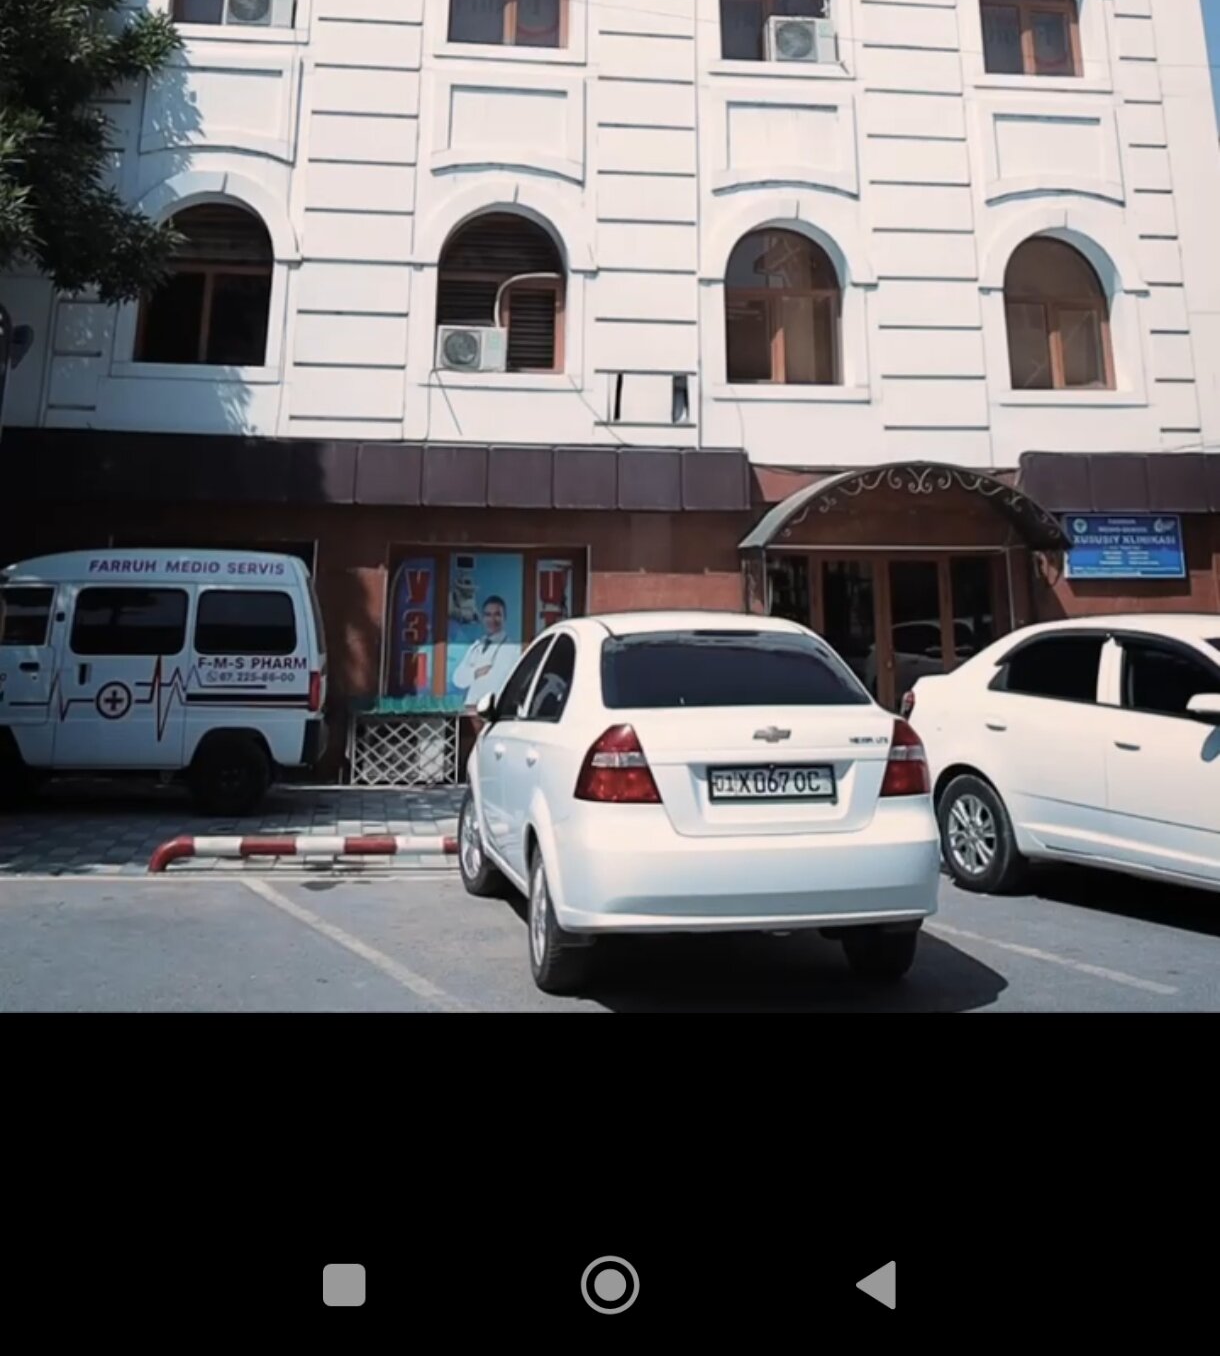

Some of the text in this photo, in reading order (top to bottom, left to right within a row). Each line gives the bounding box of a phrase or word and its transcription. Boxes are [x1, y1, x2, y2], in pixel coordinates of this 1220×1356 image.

[89, 560, 285, 575] FARRUH MEDIO SERVIS
[198, 657, 308, 670] F-M-S PHARM
